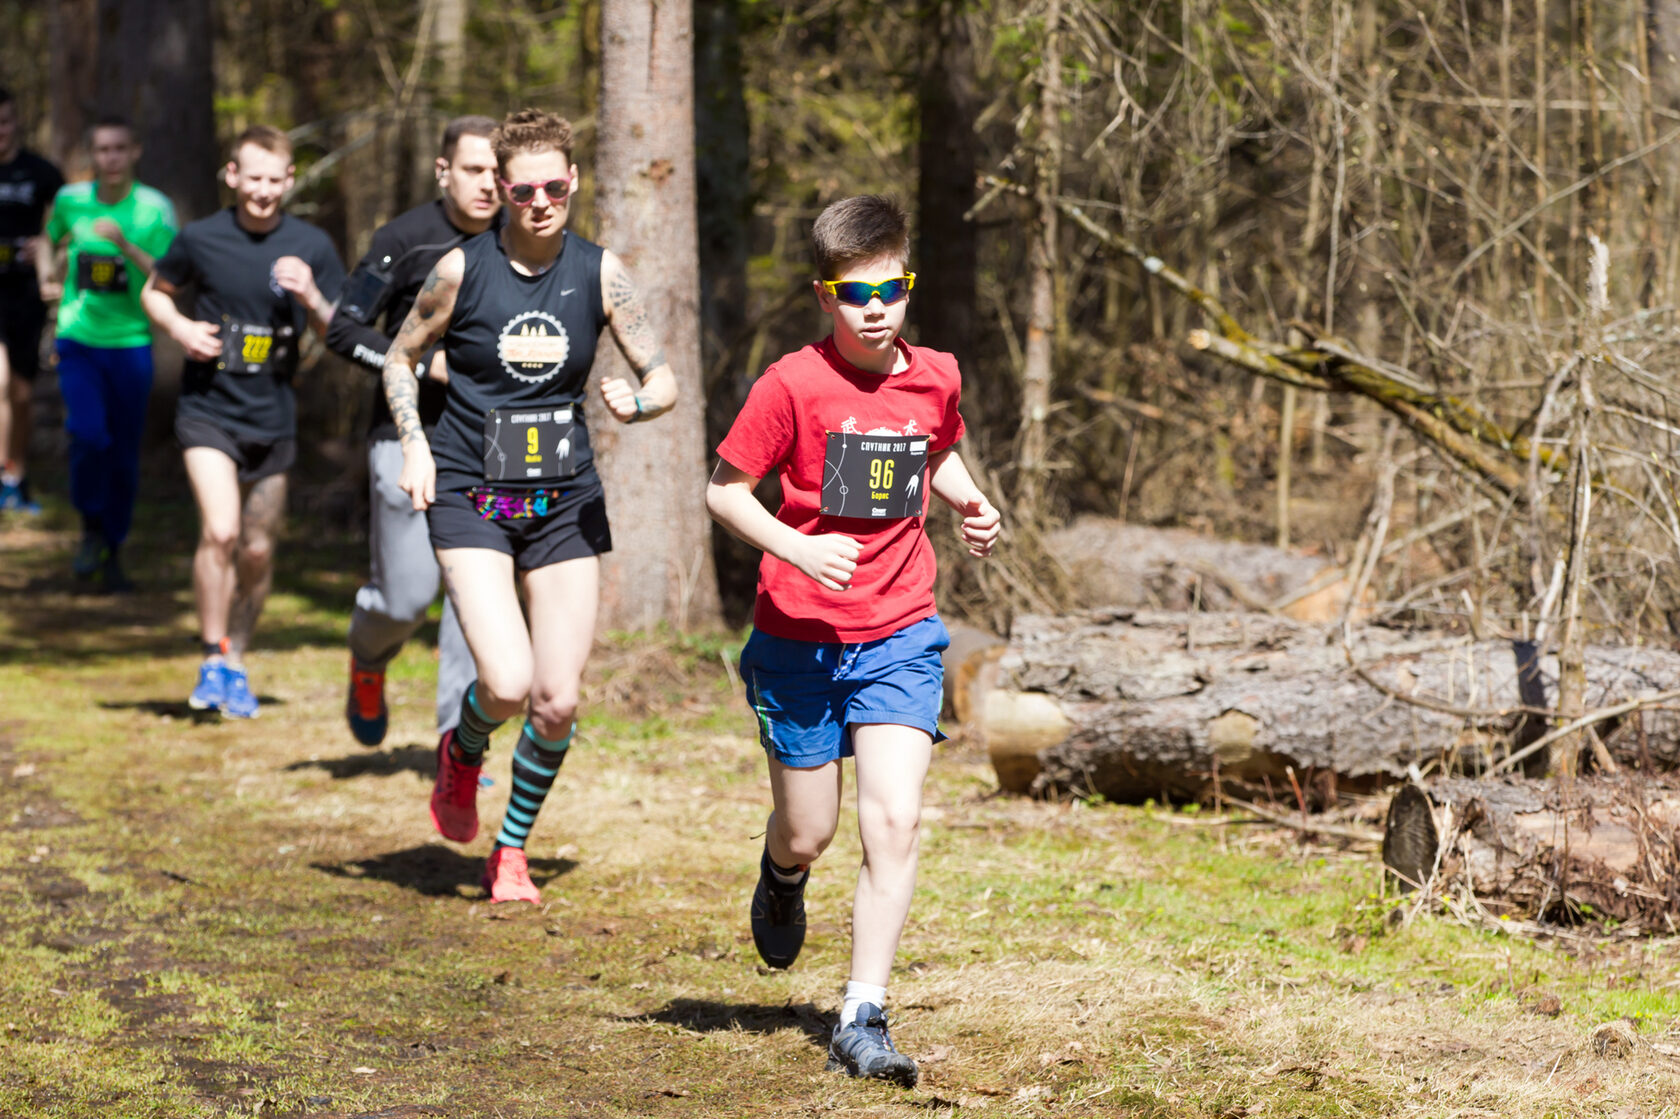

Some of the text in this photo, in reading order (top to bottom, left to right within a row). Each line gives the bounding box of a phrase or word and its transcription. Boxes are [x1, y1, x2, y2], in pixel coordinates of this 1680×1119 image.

[242, 334, 273, 358] 222
[527, 426, 539, 454] 9
[861, 442, 906, 452] СПУТНИК 2017
[870, 459, 894, 489] 96
[871, 491, 889, 500] Борис
